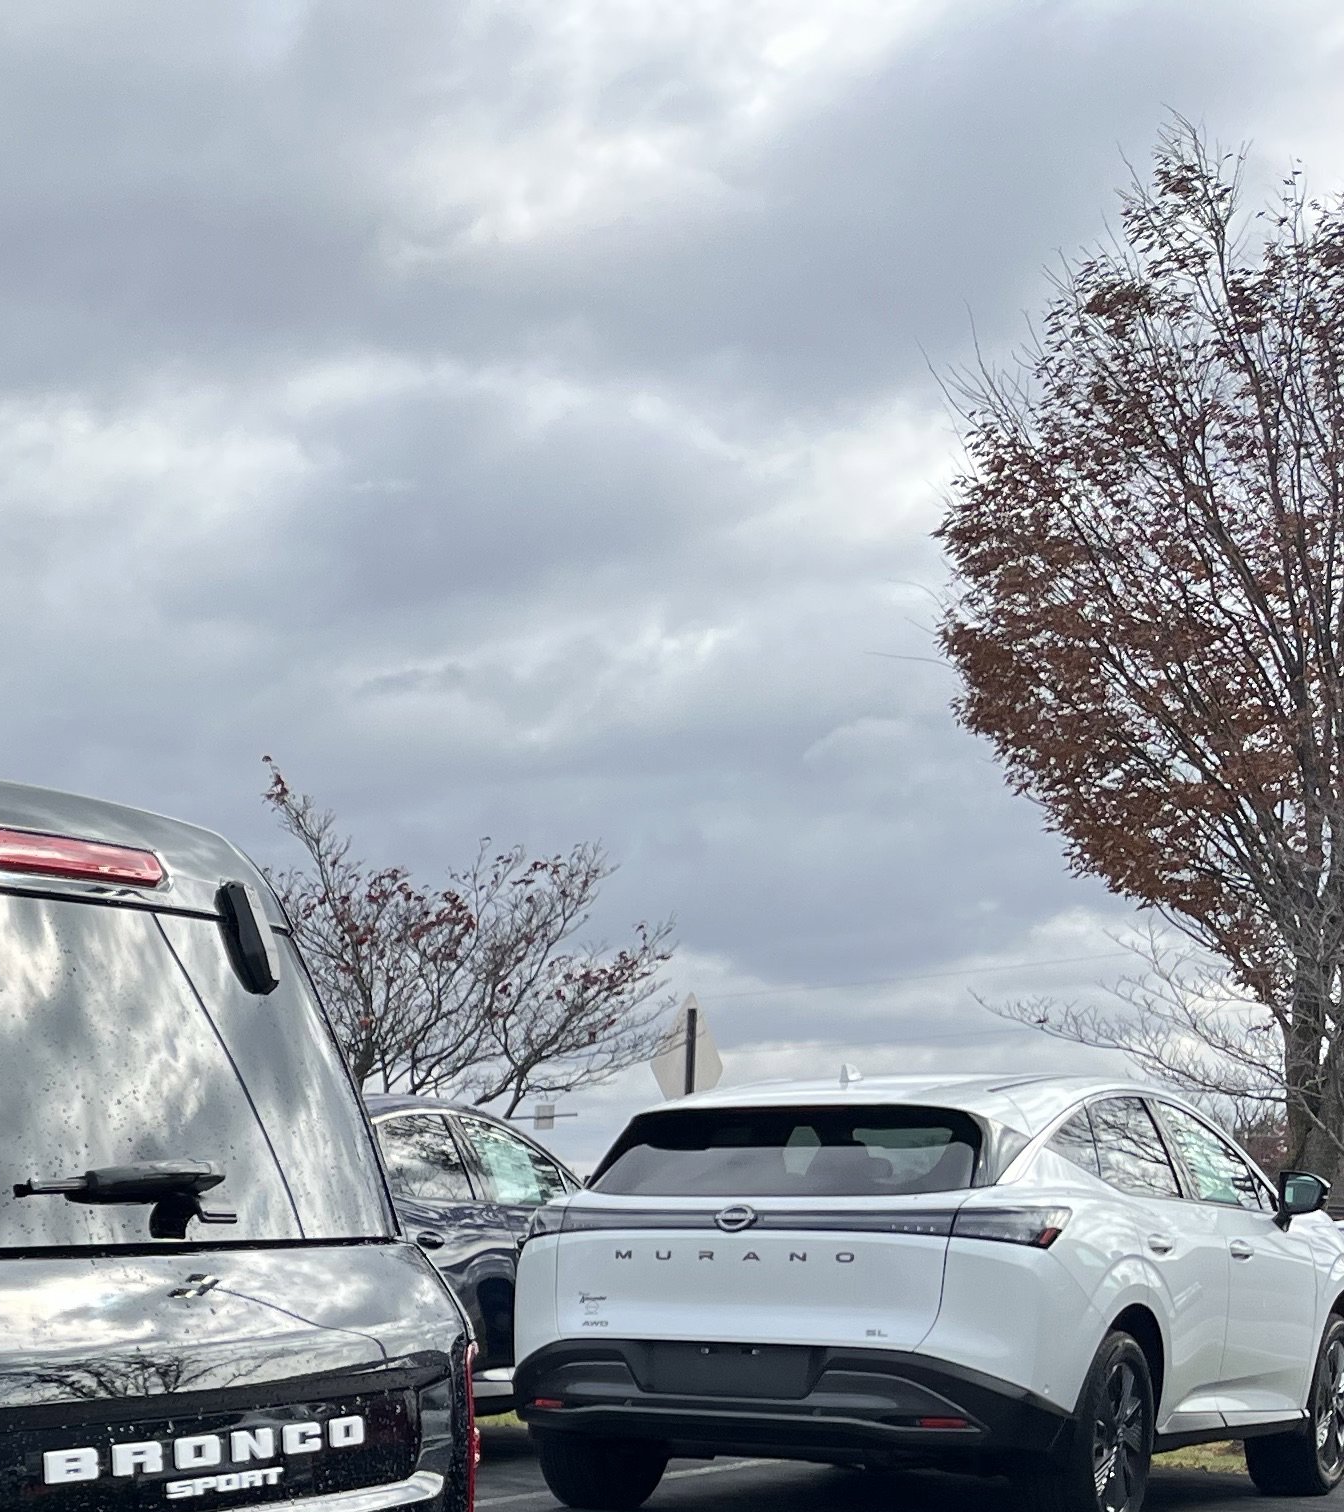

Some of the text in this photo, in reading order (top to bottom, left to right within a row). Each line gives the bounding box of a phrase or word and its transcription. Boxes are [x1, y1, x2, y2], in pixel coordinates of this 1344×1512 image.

[614, 1249, 855, 1263] MURANO
[43, 1415, 365, 1485] BRONCO
[165, 1467, 284, 1499] SPORT
